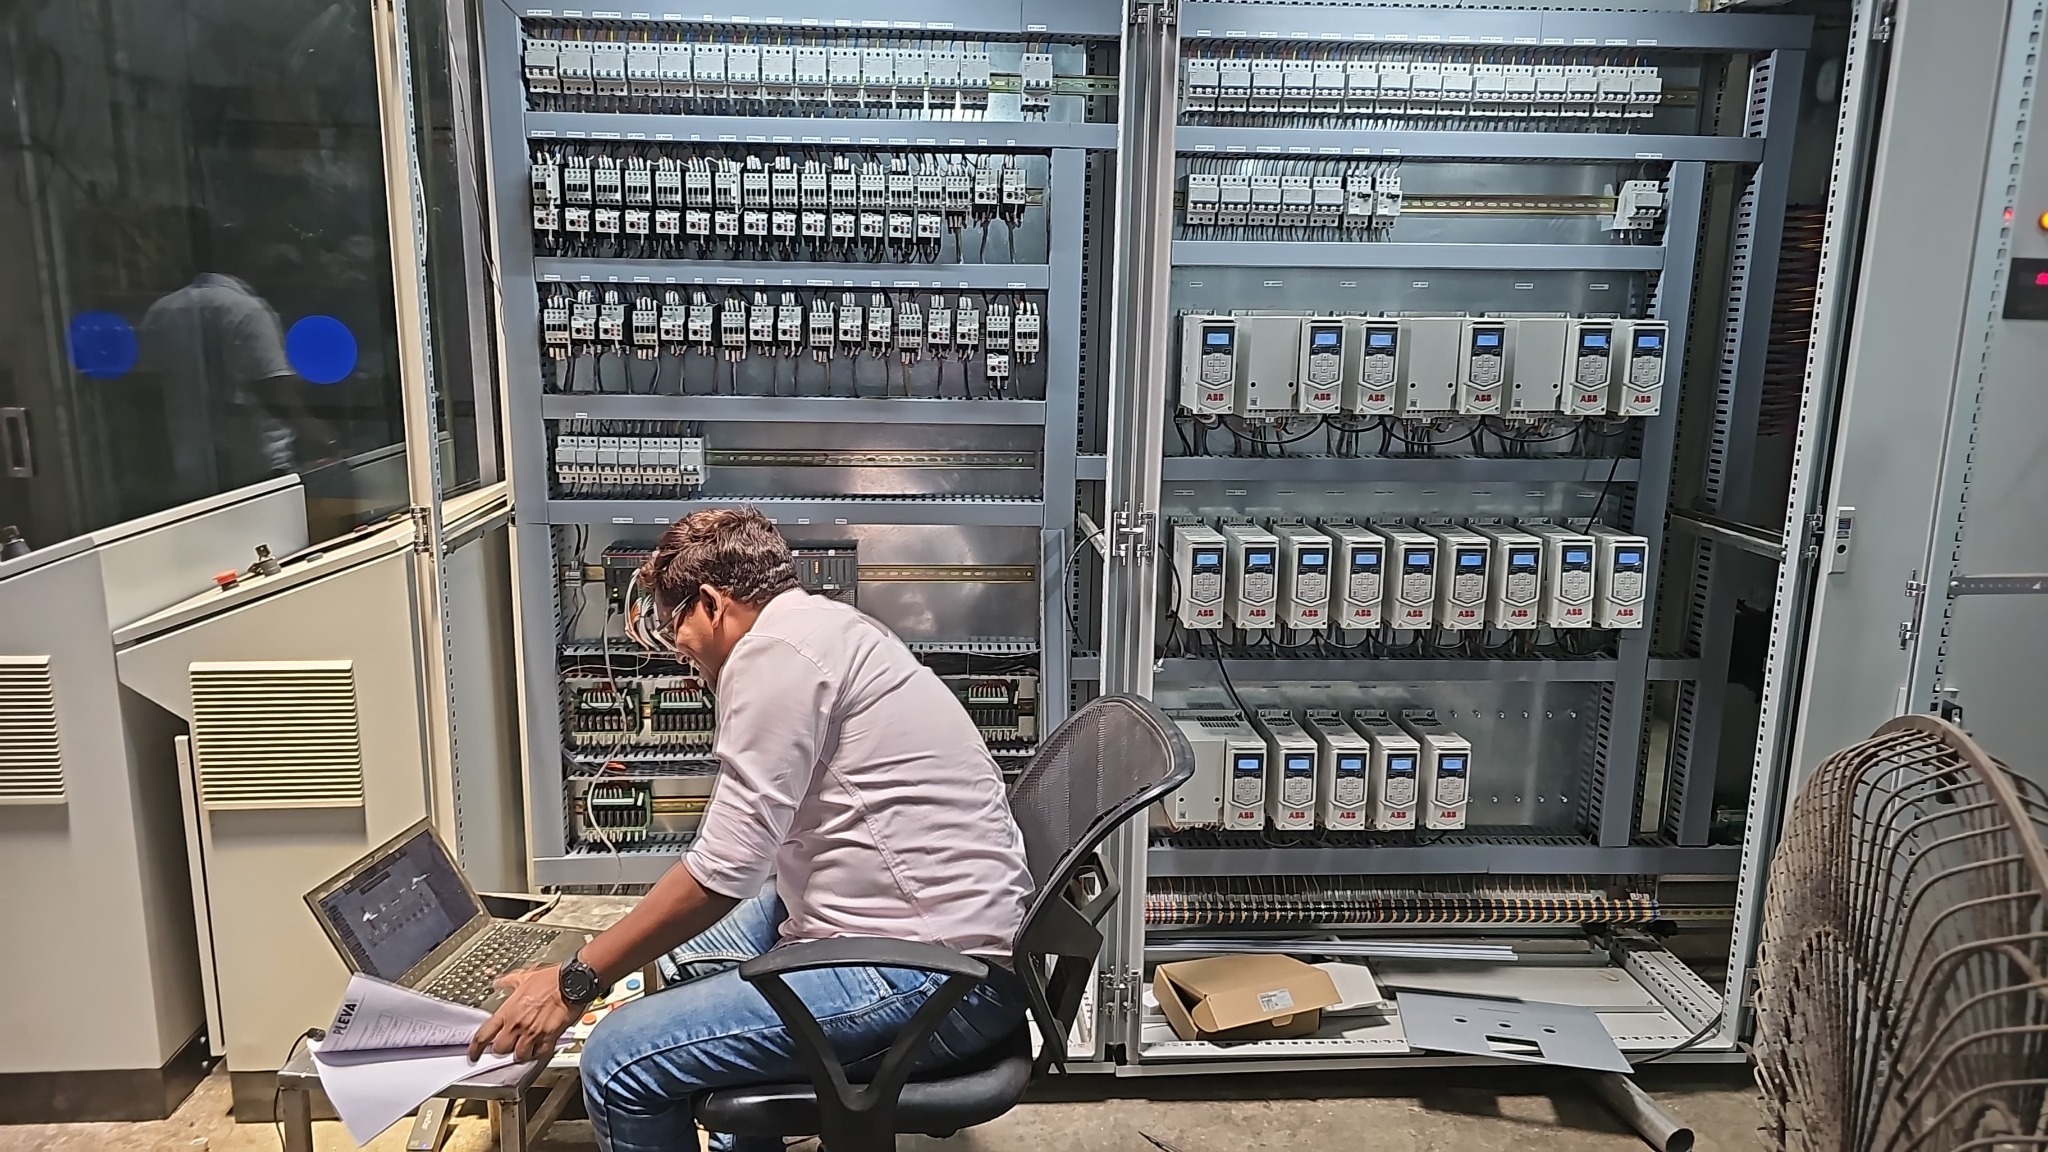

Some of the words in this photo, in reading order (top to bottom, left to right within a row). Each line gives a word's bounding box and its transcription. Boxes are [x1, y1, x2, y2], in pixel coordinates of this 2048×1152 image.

[1206, 393, 1224, 401] ABB
[1313, 393, 1331, 401] ABB
[1367, 394, 1385, 402] ABB
[1474, 394, 1492, 402] ABB
[1580, 394, 1598, 403] ABB
[1633, 395, 1651, 403] ABB
[1196, 609, 1214, 617] ABB
[1248, 609, 1266, 617] ABB
[1301, 609, 1319, 618] ABB
[1354, 609, 1372, 617] ABB
[1406, 610, 1423, 618] ABB
[1457, 610, 1475, 618] ABB
[1511, 610, 1528, 618] ABB
[1565, 608, 1583, 616] ABB
[1616, 609, 1634, 617] ABB
[1238, 811, 1254, 819] ABB
[1390, 811, 1406, 819] ABB
[1440, 811, 1457, 819] ABB
[333, 1003, 358, 1036] PLEVA
